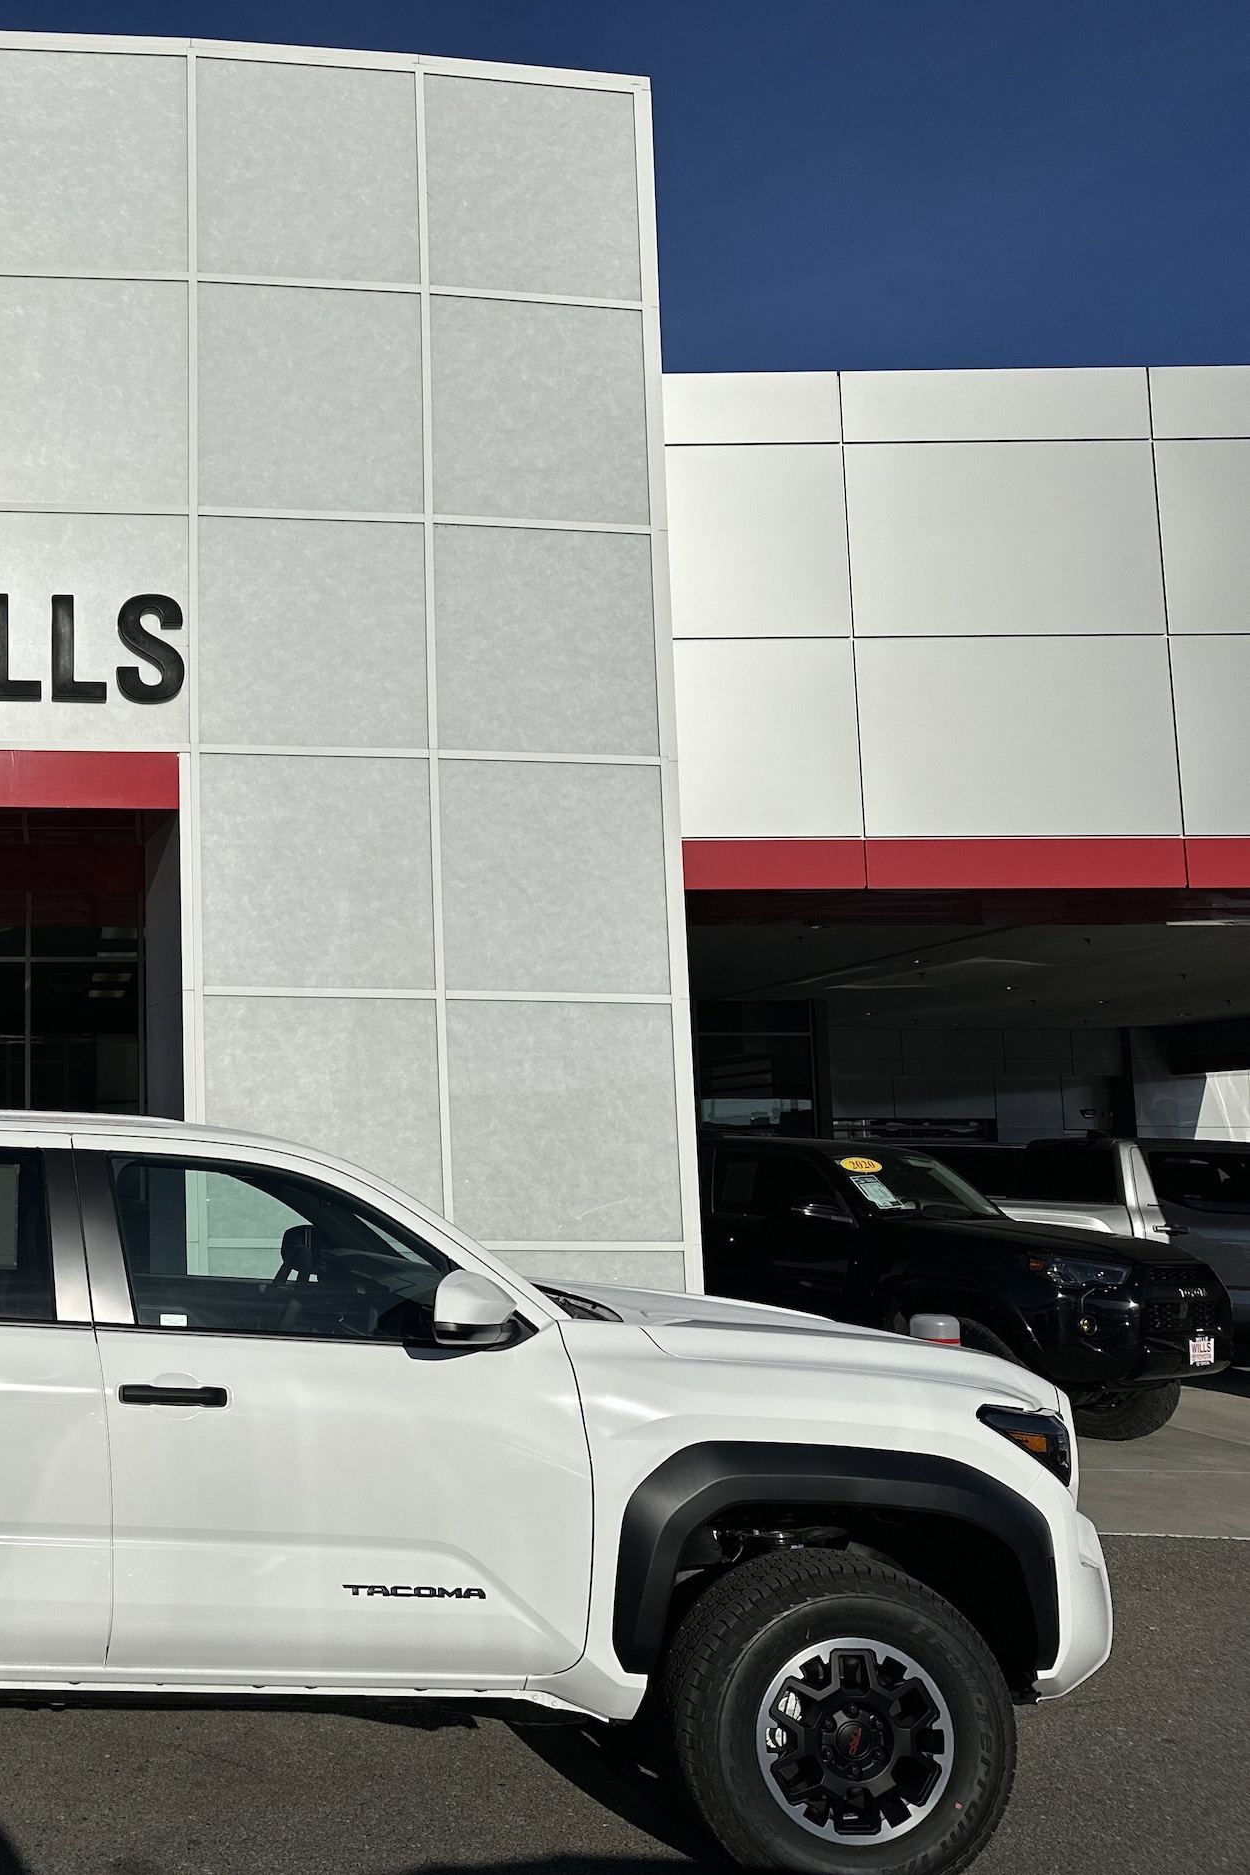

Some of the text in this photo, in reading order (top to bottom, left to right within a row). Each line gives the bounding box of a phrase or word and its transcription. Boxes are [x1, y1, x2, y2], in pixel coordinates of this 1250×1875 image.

[849, 1160, 876, 1170] 2020
[1191, 1342, 1211, 1353] WILLS
[342, 1584, 486, 1599] TACOMA
[848, 1727, 862, 1757] TRD
